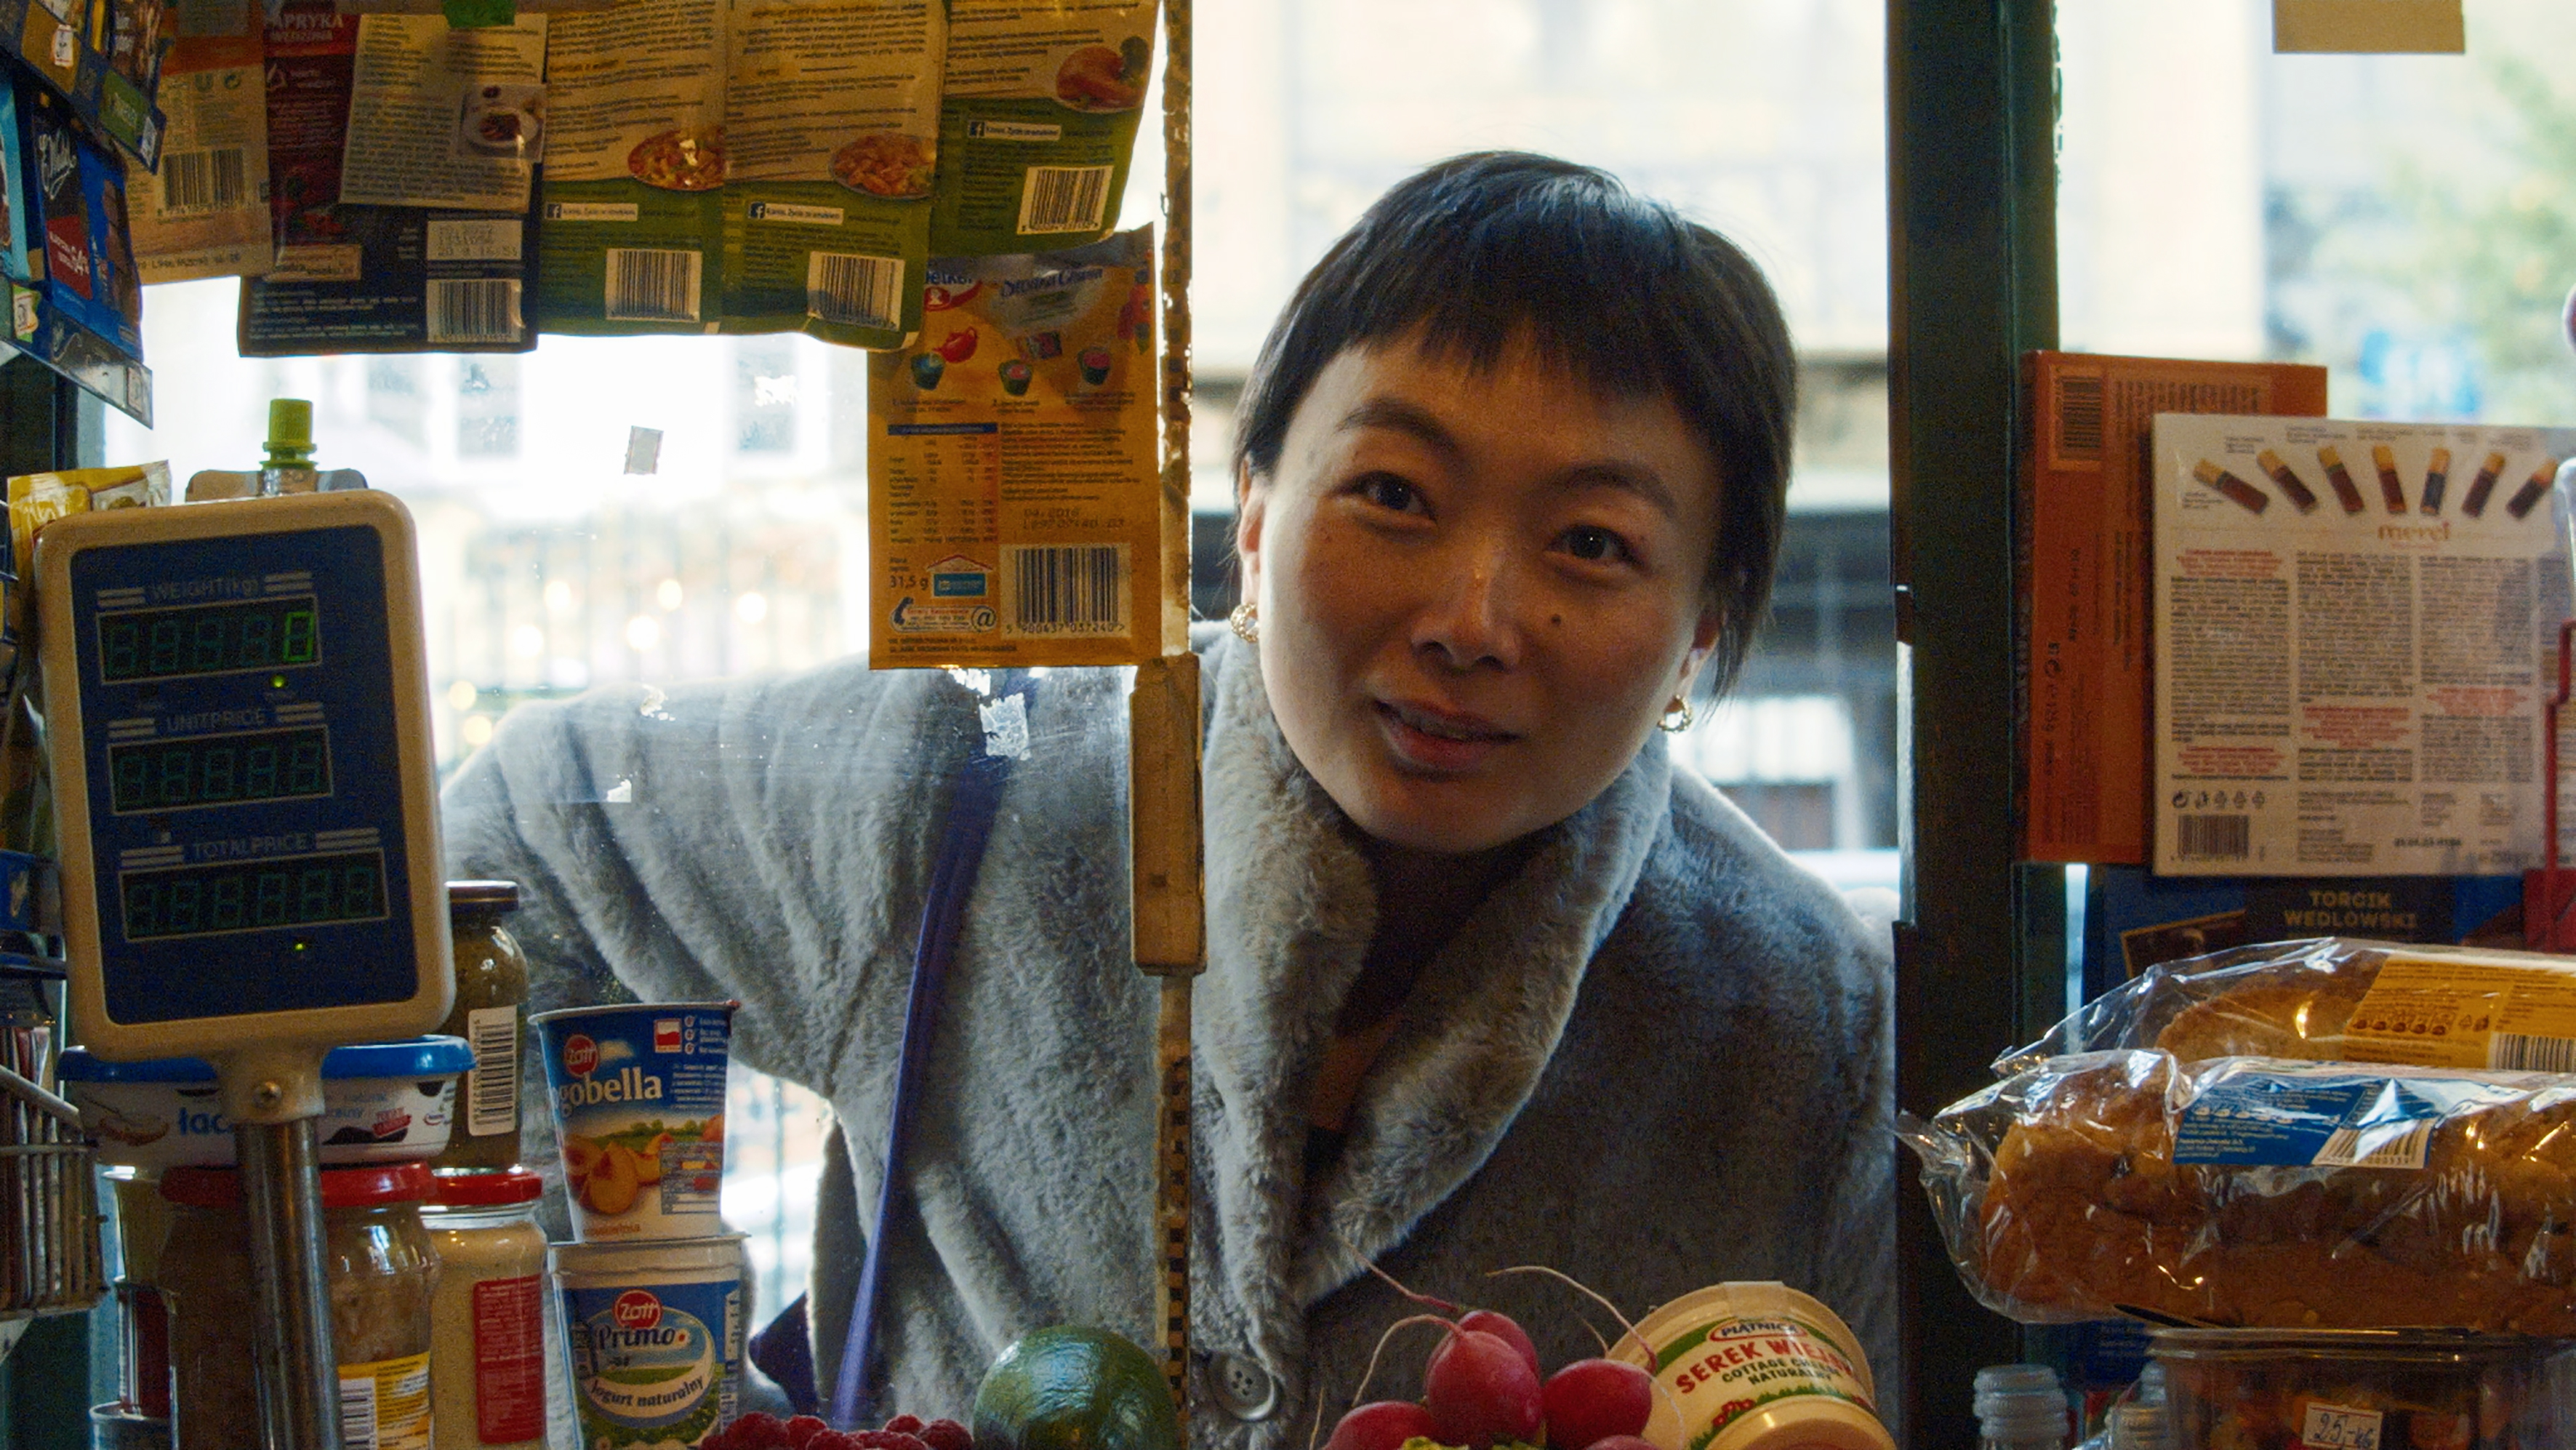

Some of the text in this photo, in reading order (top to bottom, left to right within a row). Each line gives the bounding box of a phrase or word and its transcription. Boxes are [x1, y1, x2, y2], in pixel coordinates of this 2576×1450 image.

[2378, 521, 2450, 540] merci
[2308, 889, 2392, 909] TORCIK
[553, 1066, 662, 1118] gobella
[619, 1302, 659, 1321] Zott
[598, 1323, 676, 1350] Primo
[1675, 1340, 1763, 1394] SEREK
[1720, 1357, 1786, 1384] COTTAGE
[590, 1375, 705, 1406] Jogurt naturalny
